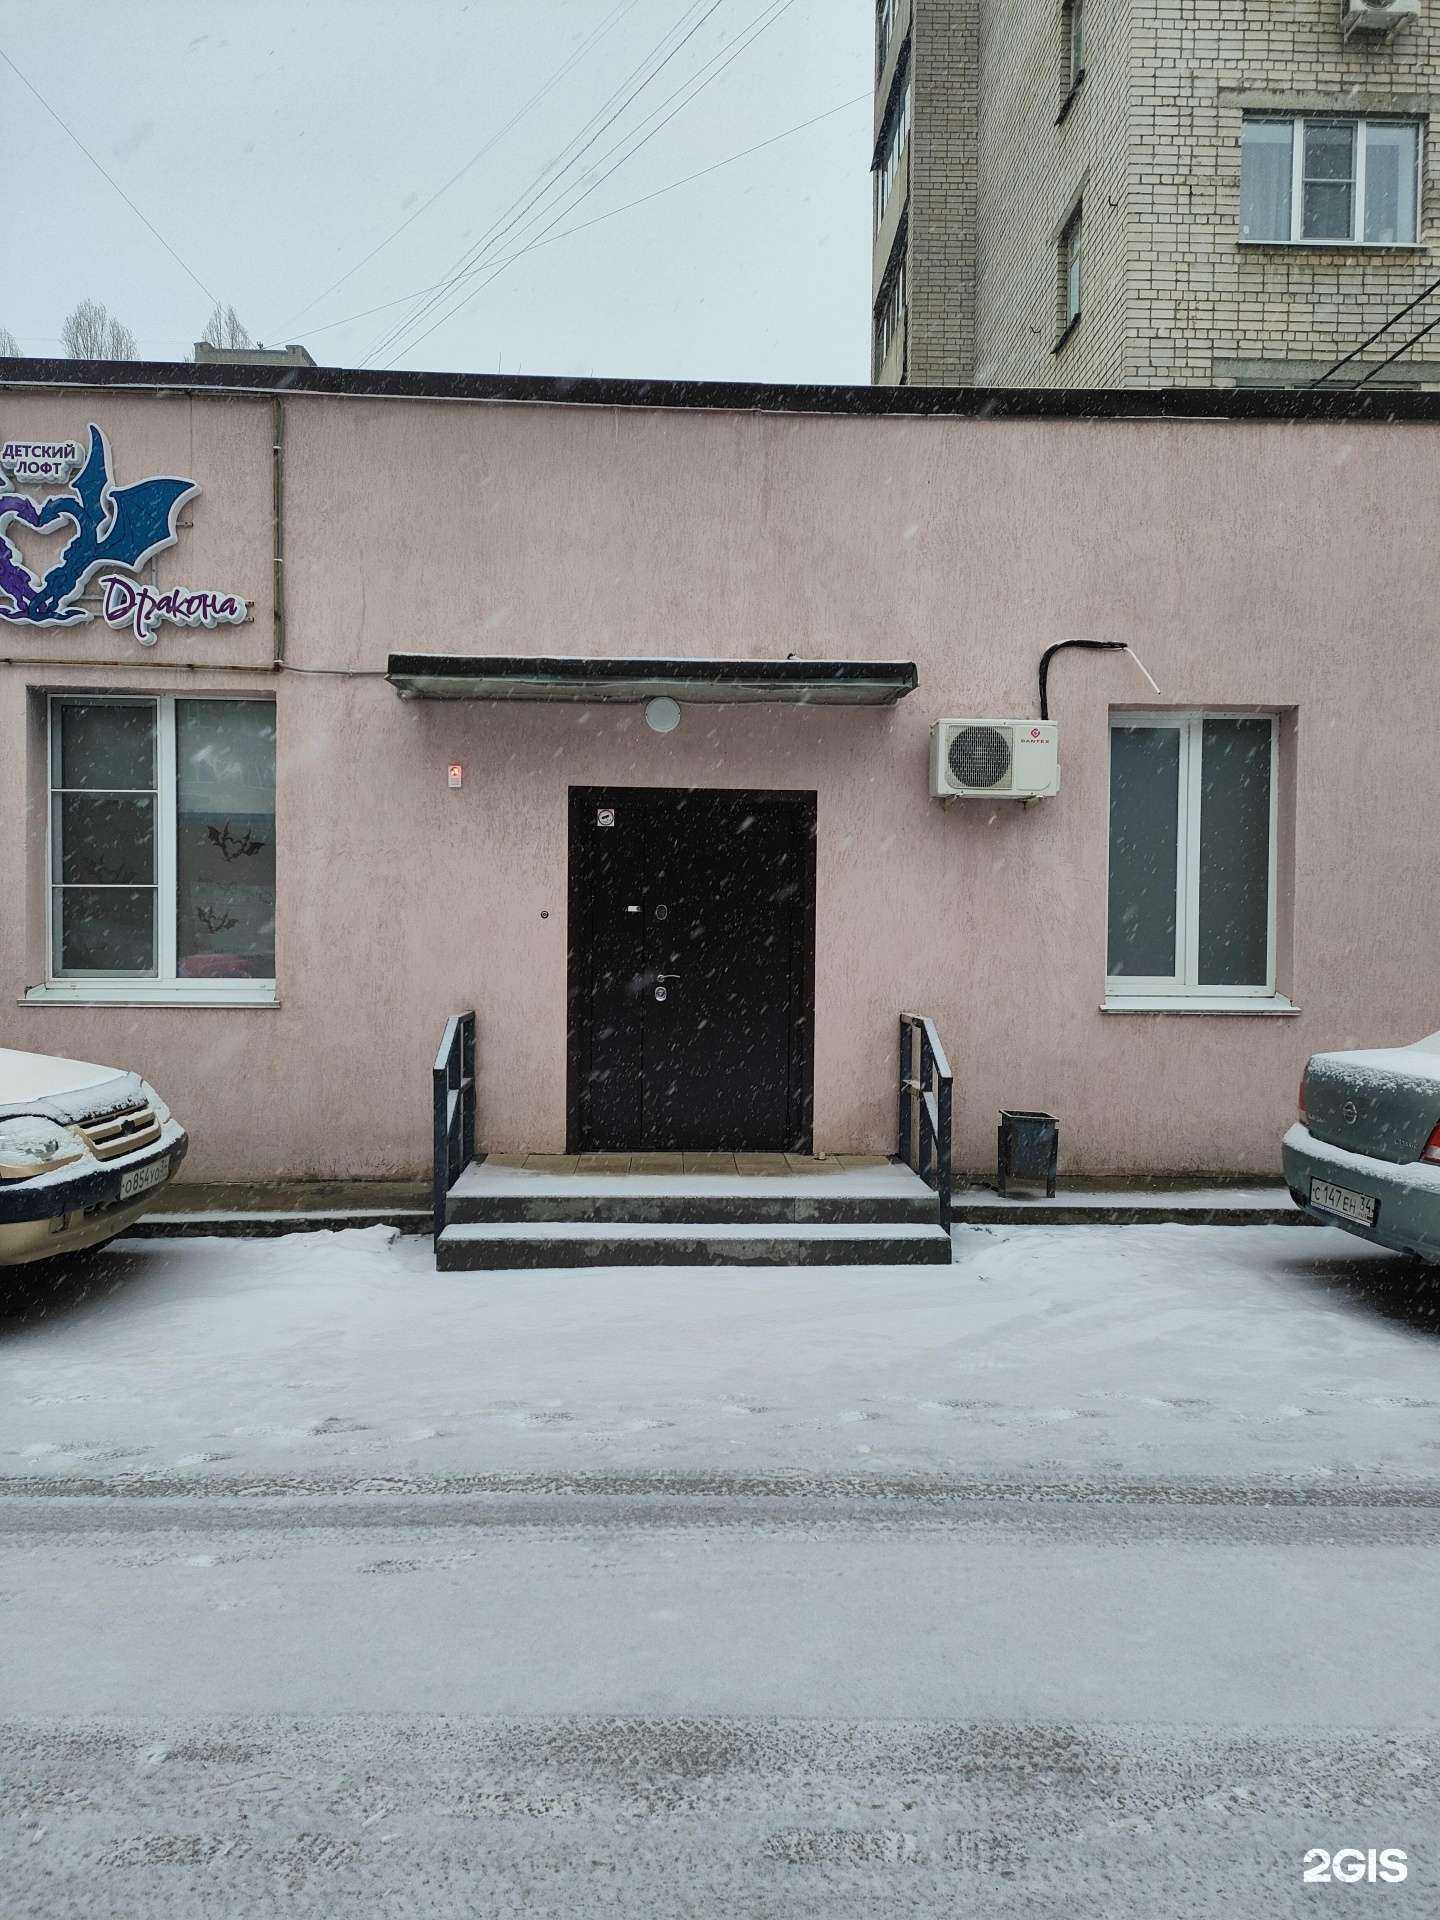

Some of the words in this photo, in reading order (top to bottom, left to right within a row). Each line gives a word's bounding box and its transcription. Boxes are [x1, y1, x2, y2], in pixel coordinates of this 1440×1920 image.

[2, 443, 75, 459] ДЕТСКИЙ
[16, 461, 61, 474] ЛОФТ
[101, 577, 238, 638] Дракона
